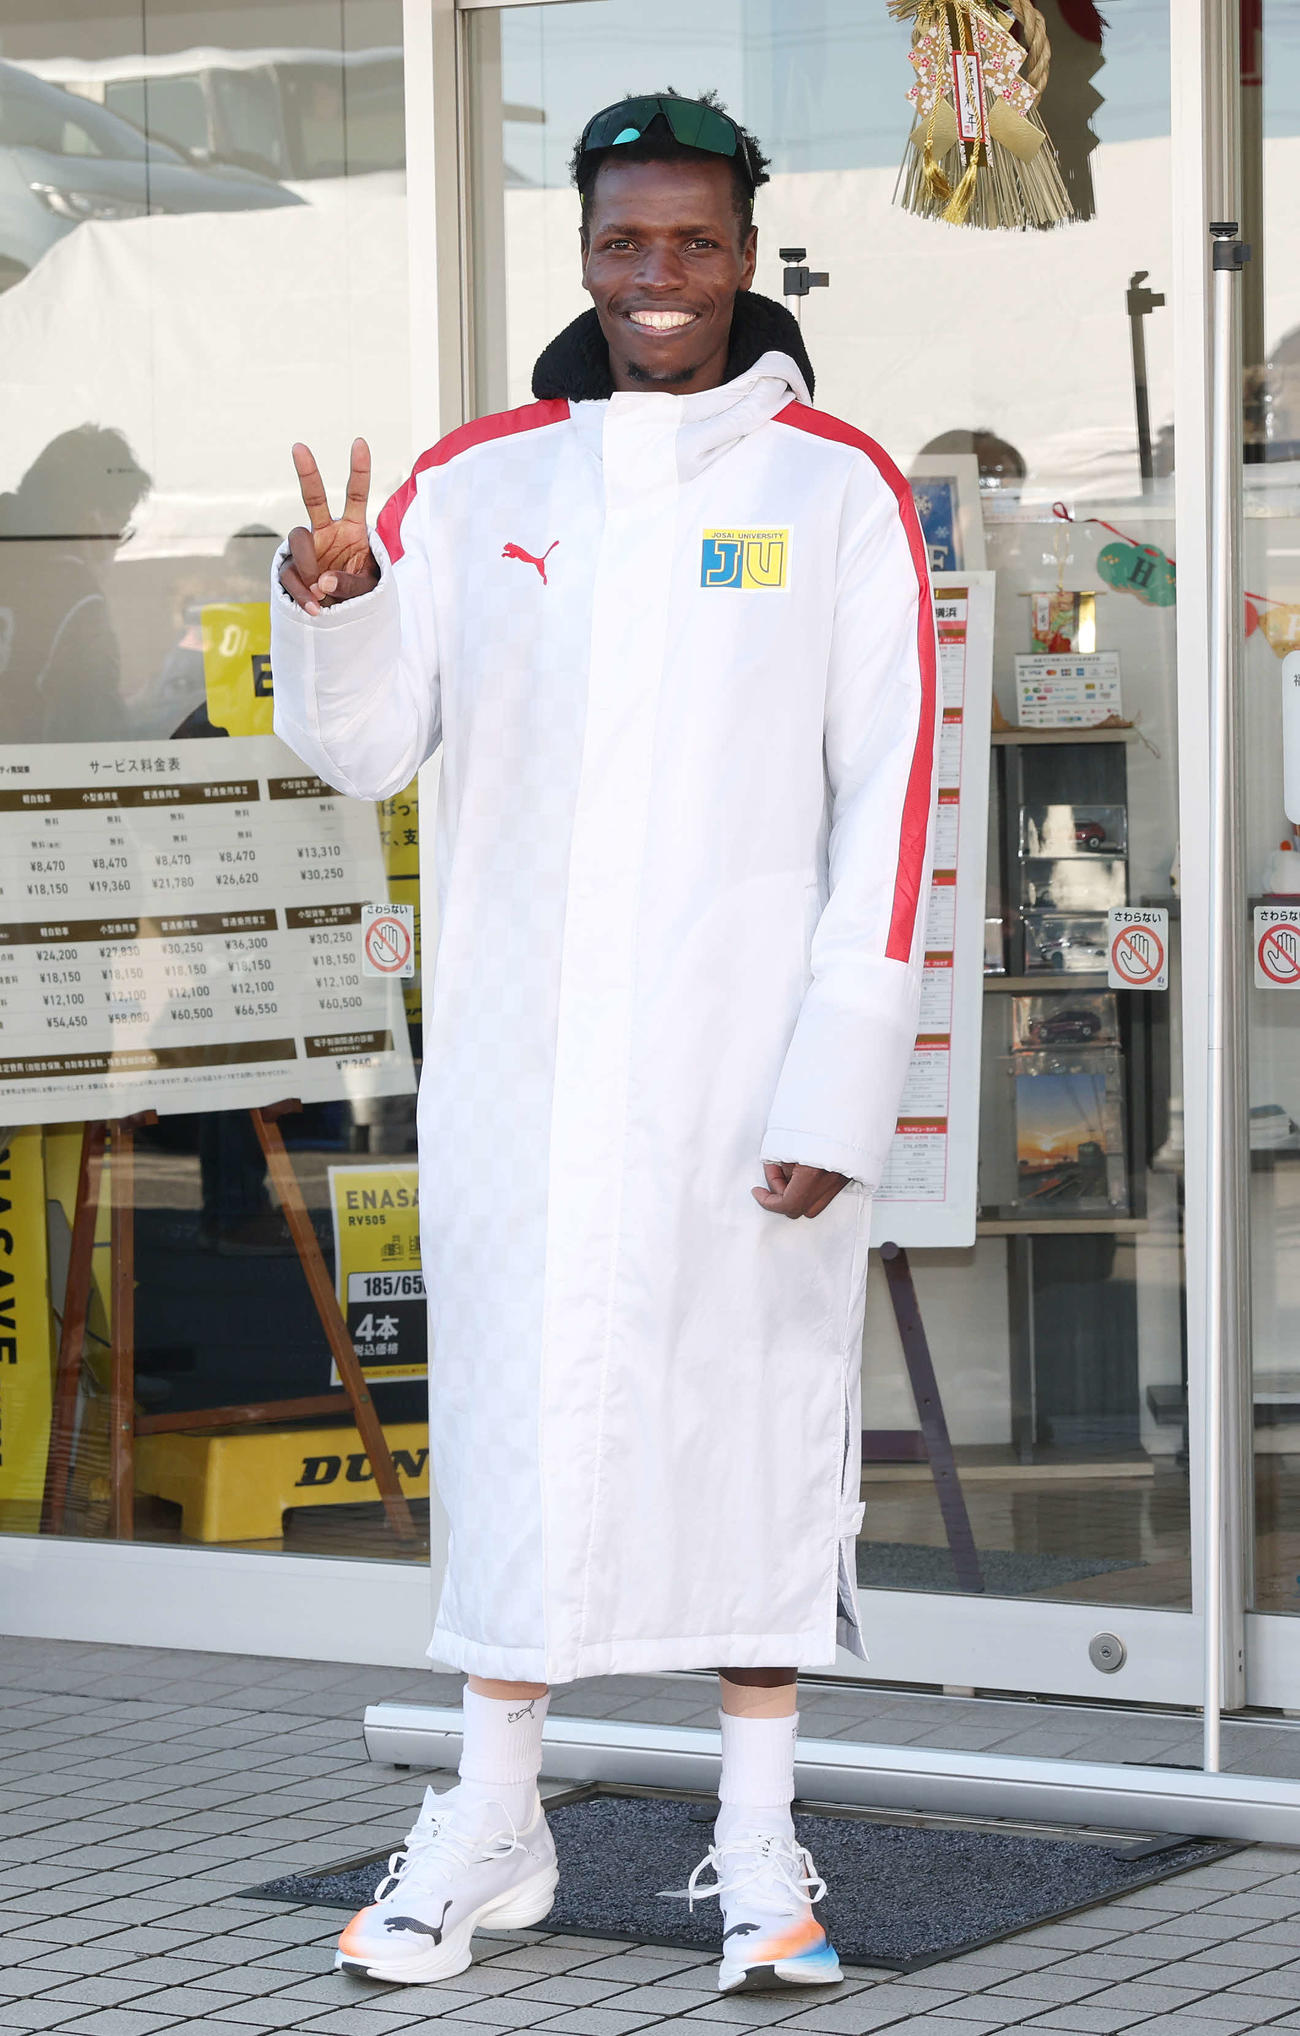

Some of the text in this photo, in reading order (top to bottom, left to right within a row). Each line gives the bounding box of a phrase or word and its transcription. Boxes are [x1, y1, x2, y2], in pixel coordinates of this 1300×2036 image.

[738, 532, 784, 540] UNIVERSITY
[705, 540, 784, 587] JU
[1127, 556, 1157, 589] H
[89, 757, 181, 775] サービス料金表
[30, 845, 341, 872] ¥8,470 ¥8,470 ¥8,470 ¥8,470 ¥13,310
[27, 883, 69, 896] ¥18,150
[89, 880, 131, 893] ¥19,360
[216, 873, 259, 886] ¥26,620
[300, 867, 344, 881] ¥30,250
[1114, 912, 1161, 923] さわらない
[1260, 910, 1300, 922] さわらな
[36, 949, 78, 961] ¥24,200
[99, 945, 141, 959] ¥27,830
[161, 941, 204, 955] ¥30,250
[225, 937, 268, 951] ¥36,300
[309, 932, 353, 945] ¥30,250
[40, 971, 81, 984] ¥18,150
[165, 963, 207, 977] ¥18,150
[312, 953, 356, 967] ¥18,150
[42, 993, 85, 1006] ¥12,100
[168, 985, 210, 999] ¥12,100
[231, 981, 275, 995] ¥12,100
[316, 975, 359, 989] ¥12,100
[46, 1015, 88, 1029] ¥54,450
[171, 1007, 213, 1021] ¥60,500
[235, 1002, 278, 1017] ¥66,550
[319, 996, 362, 1010] ¥60,500
[348, 1214, 387, 1227] RV505
[363, 1275, 426, 1297] 185/65
[355, 1313, 399, 1342] 4本
[353, 1342, 399, 1356] 税込価格
